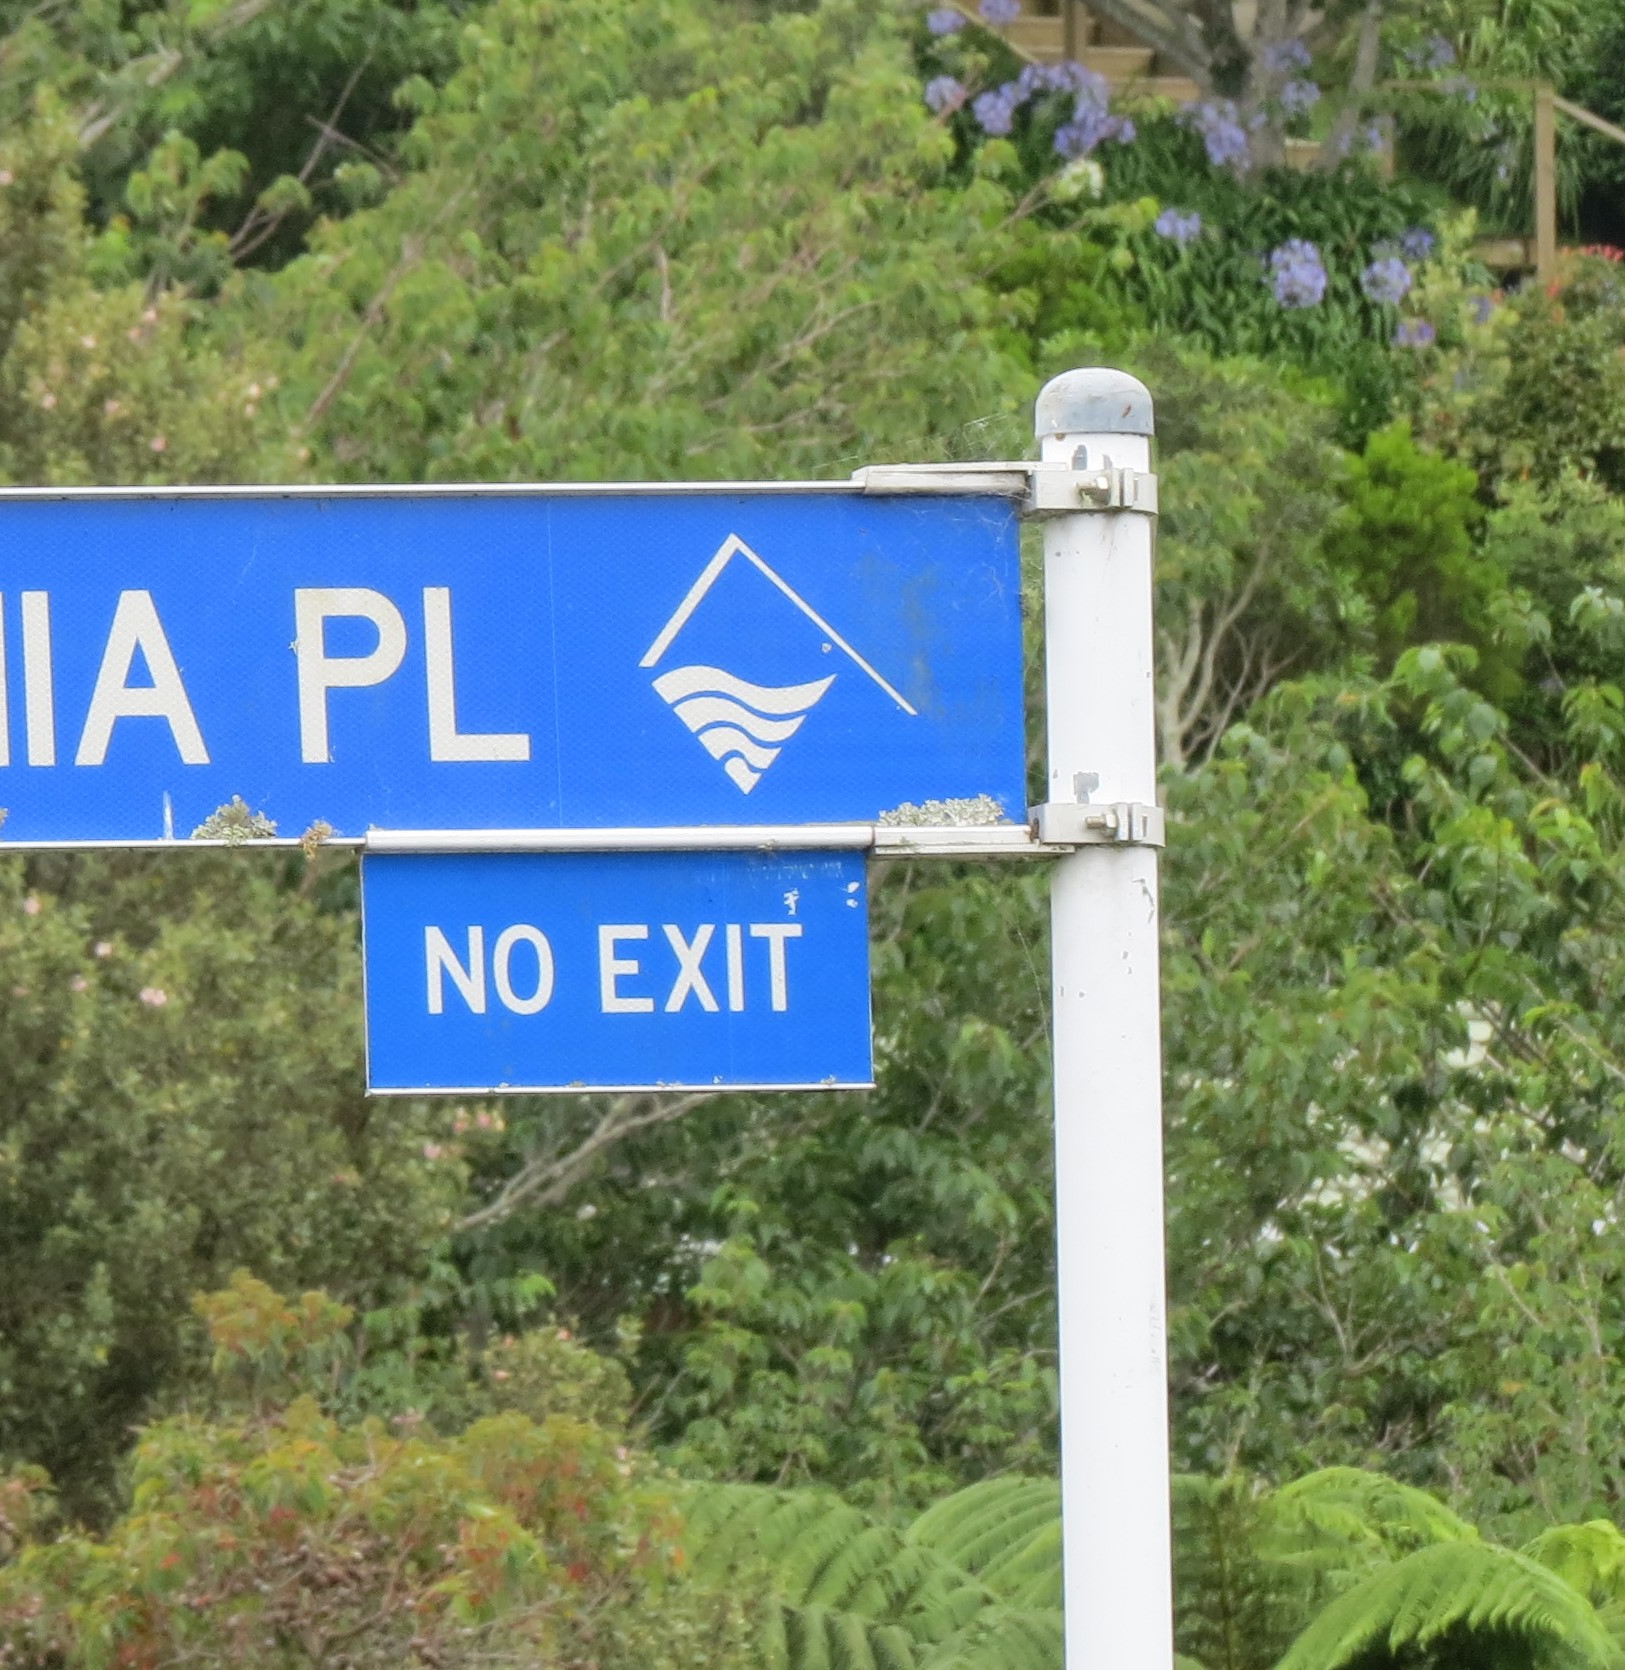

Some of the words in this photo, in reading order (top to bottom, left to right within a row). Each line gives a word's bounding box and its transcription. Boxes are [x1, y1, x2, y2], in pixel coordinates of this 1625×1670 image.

[294, 587, 530, 763] PL
[425, 924, 554, 1014] NO
[599, 923, 802, 1013] EXIT
